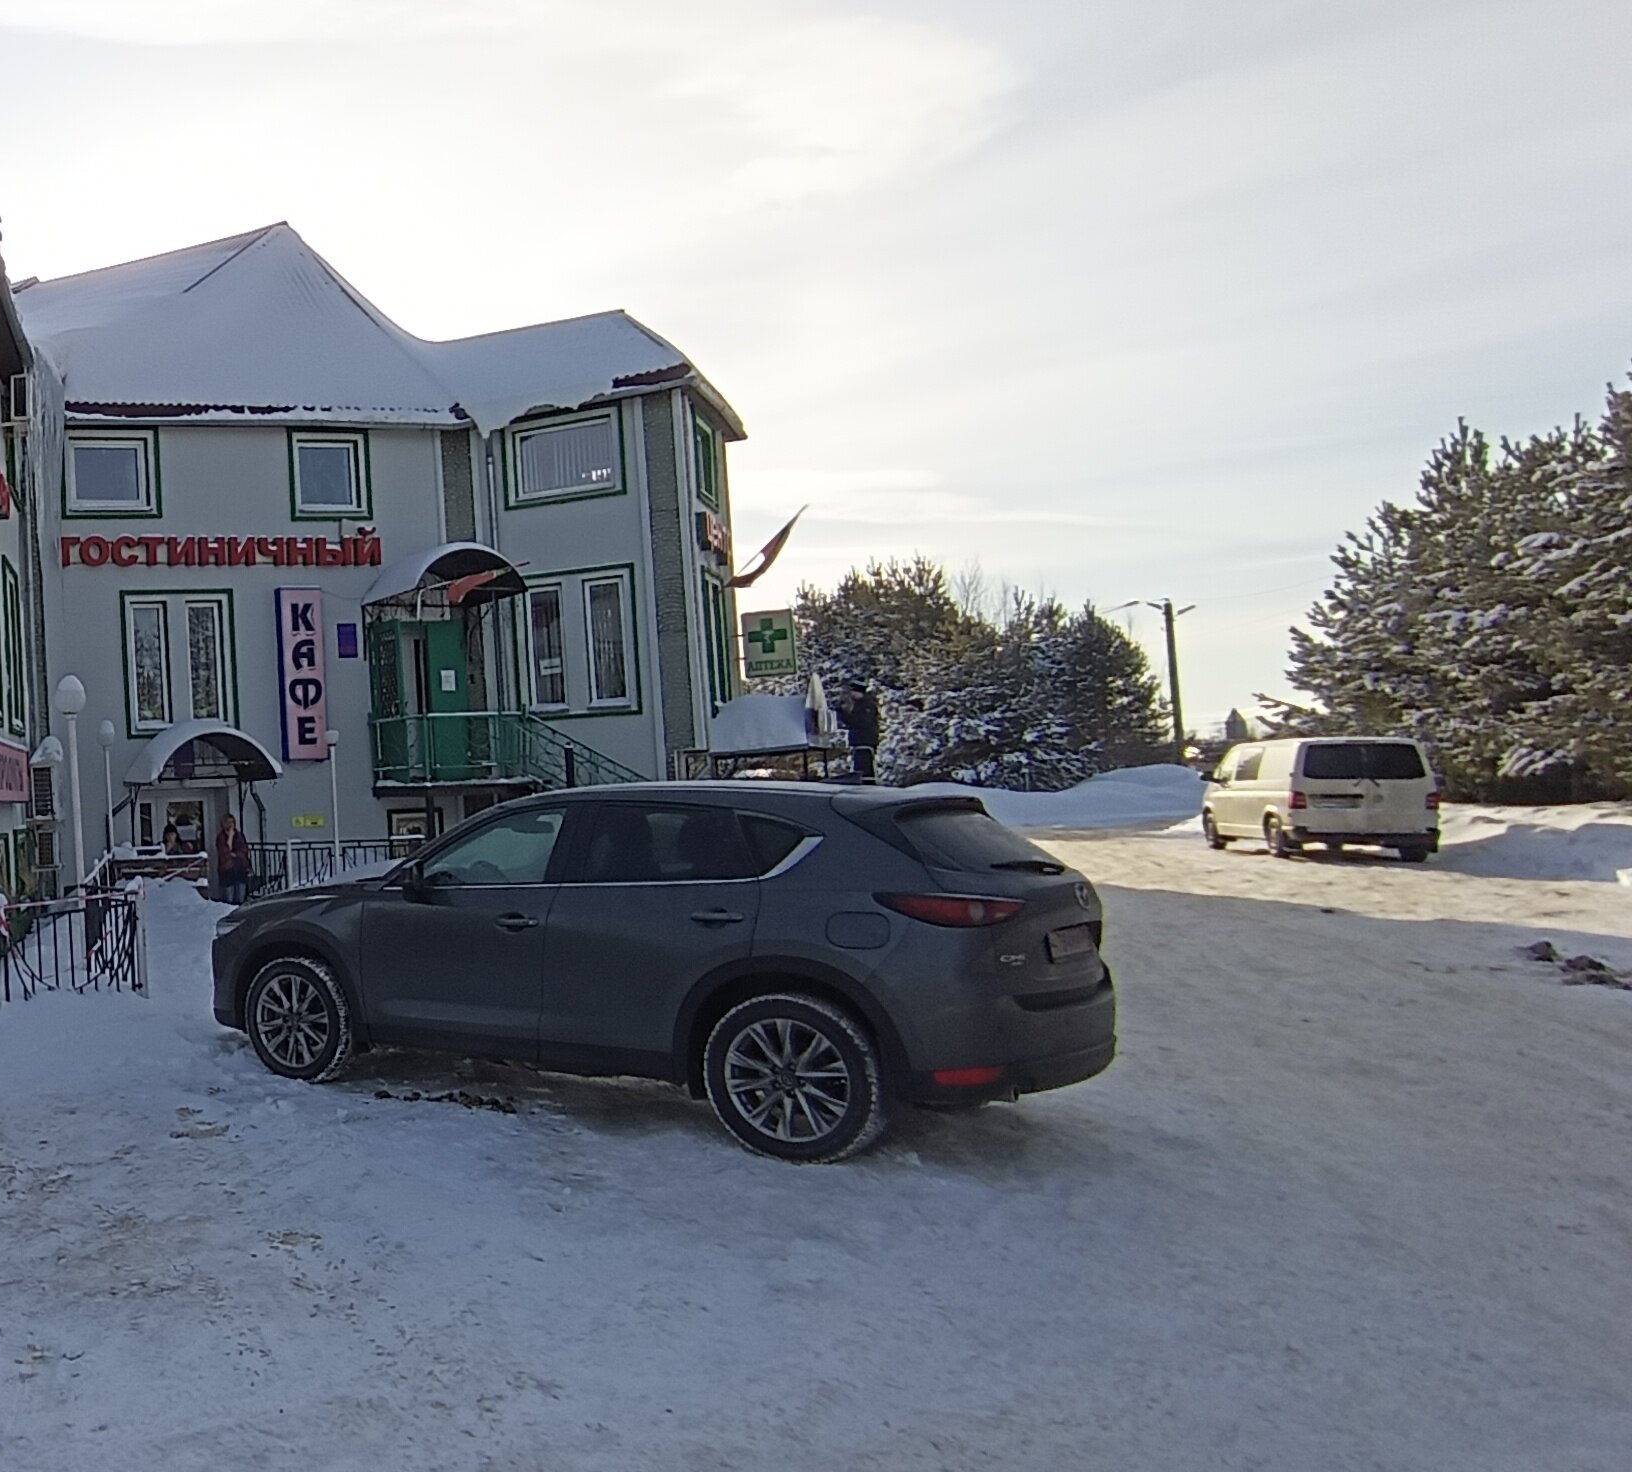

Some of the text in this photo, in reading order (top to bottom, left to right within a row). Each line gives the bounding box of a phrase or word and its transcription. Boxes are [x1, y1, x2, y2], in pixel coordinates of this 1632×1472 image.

[60, 526, 382, 568] ГОСТИНИЧНЫЙ
[288, 602, 323, 746] КАФЕ
[748, 658, 794, 672] АПТЕКА
